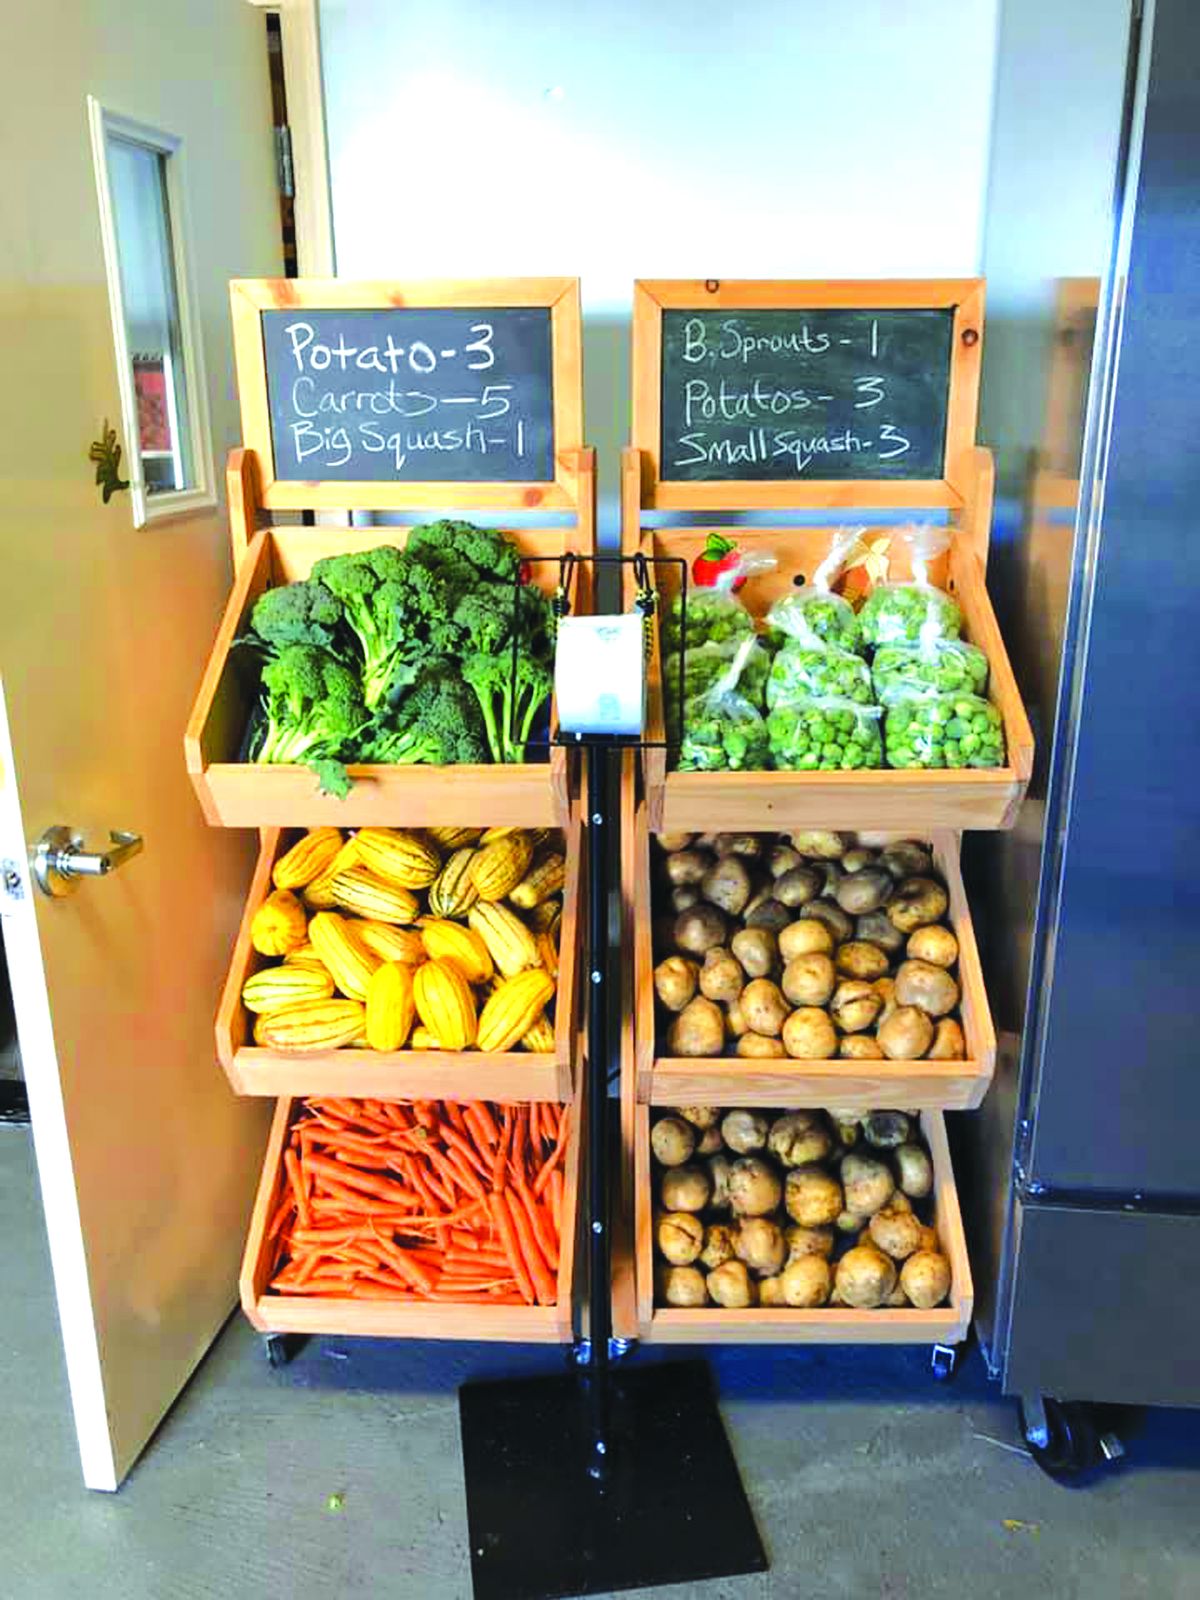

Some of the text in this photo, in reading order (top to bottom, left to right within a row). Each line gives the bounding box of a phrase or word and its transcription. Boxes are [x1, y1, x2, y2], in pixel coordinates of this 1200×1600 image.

[682, 318, 716, 363] B.
[853, 376, 886, 409] 3
[290, 420, 353, 467] Big
[674, 429, 767, 467] Small
